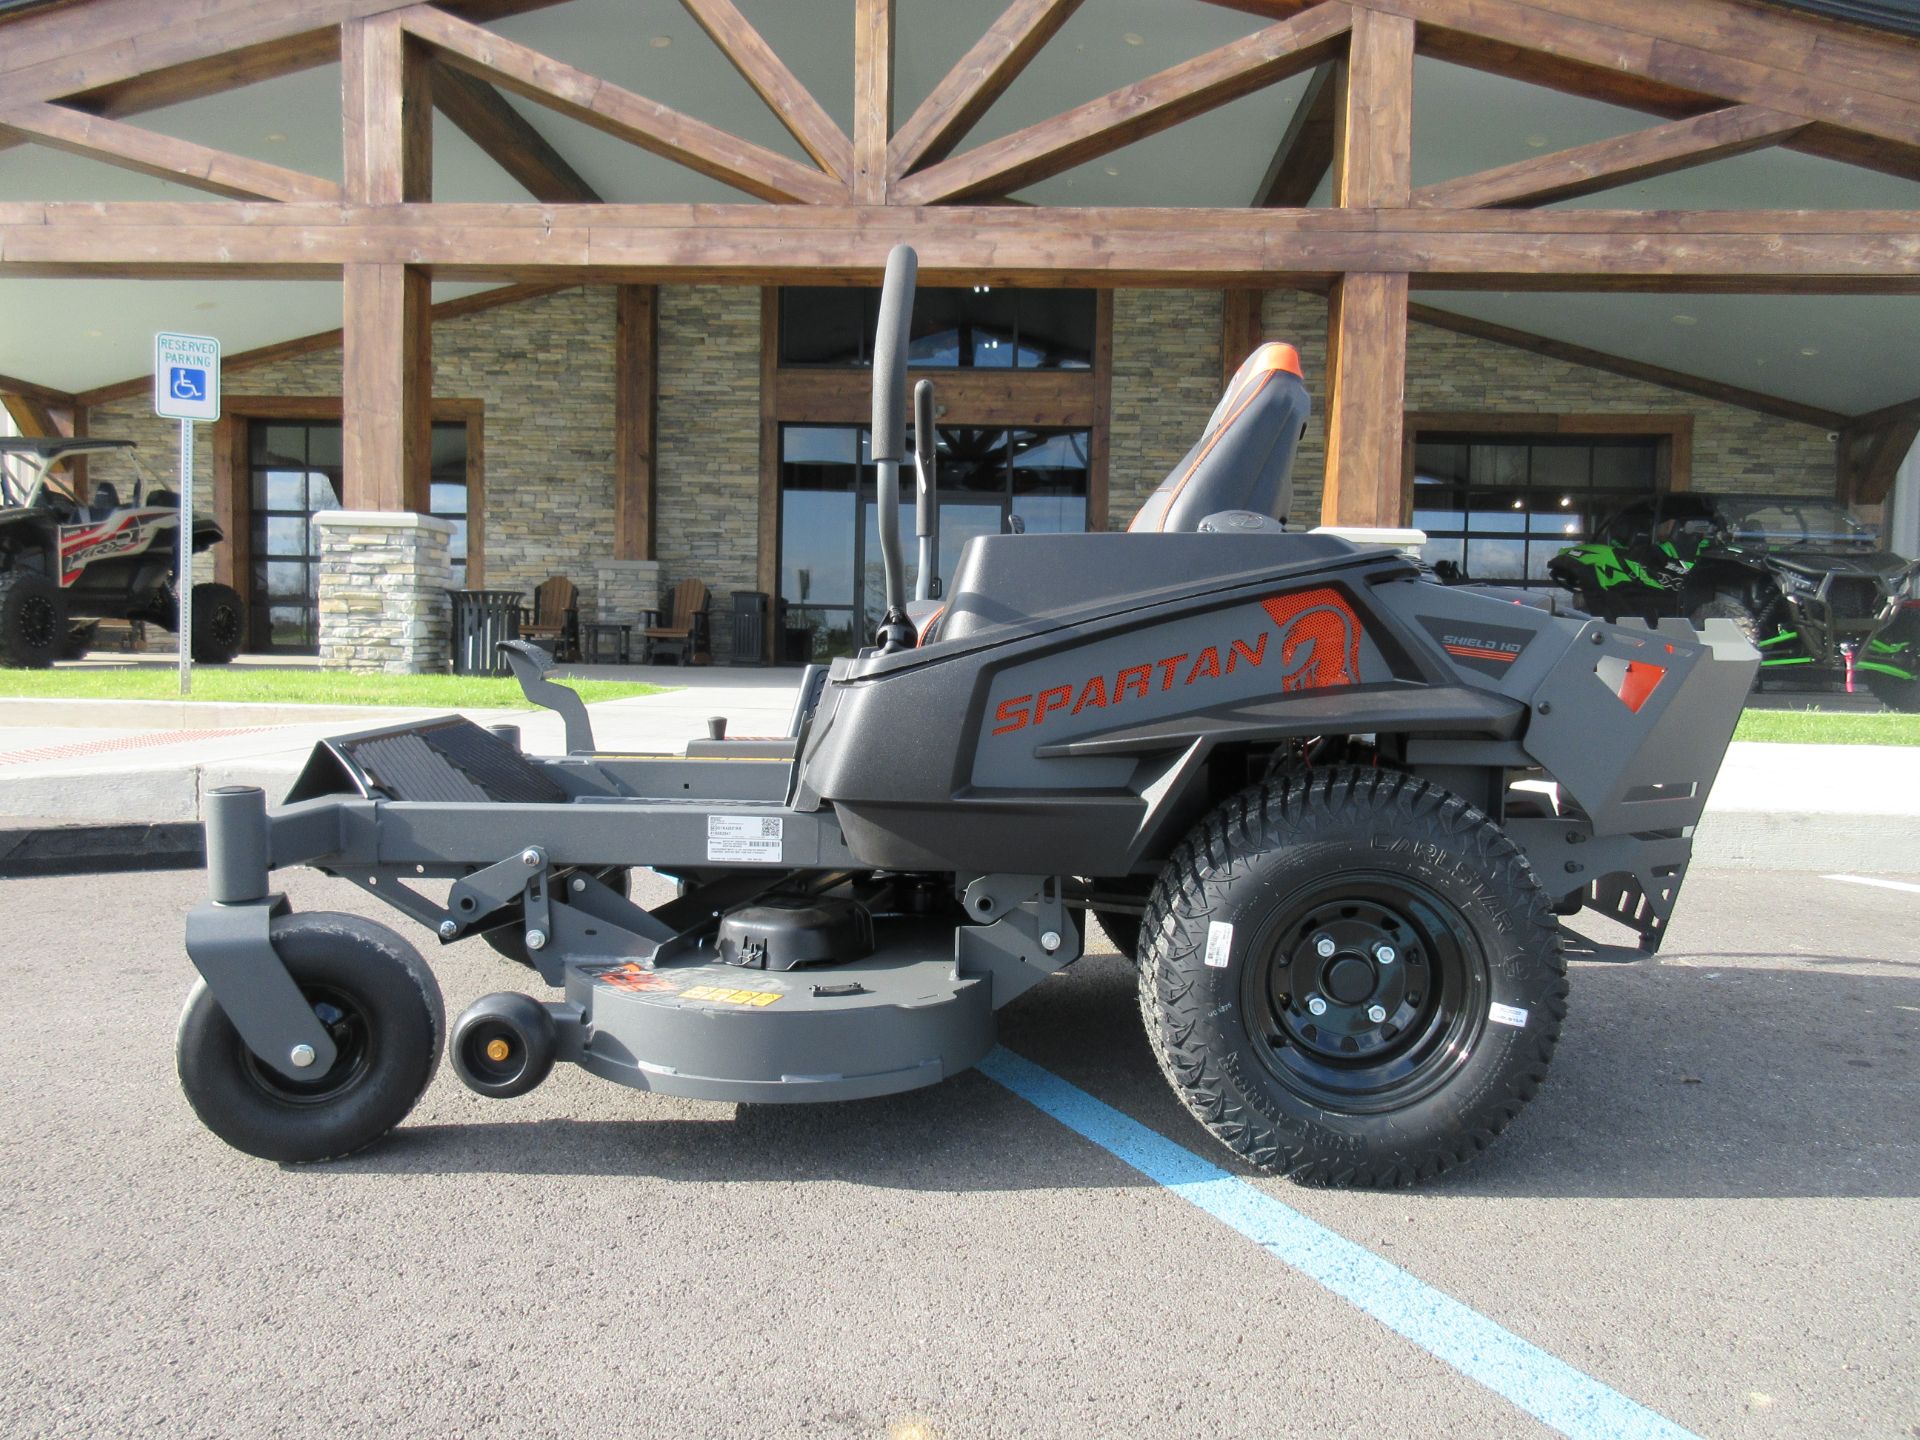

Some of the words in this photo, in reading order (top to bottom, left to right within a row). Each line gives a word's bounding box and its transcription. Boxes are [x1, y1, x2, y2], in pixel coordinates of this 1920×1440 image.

[160, 338, 216, 354] RESERVED
[165, 352, 211, 367] PARKING
[1441, 635, 1496, 649] SHIELD
[1500, 642, 1522, 652] HD
[992, 632, 1268, 736] SPARTAN
[1370, 833, 1514, 935] CARLSTAR
